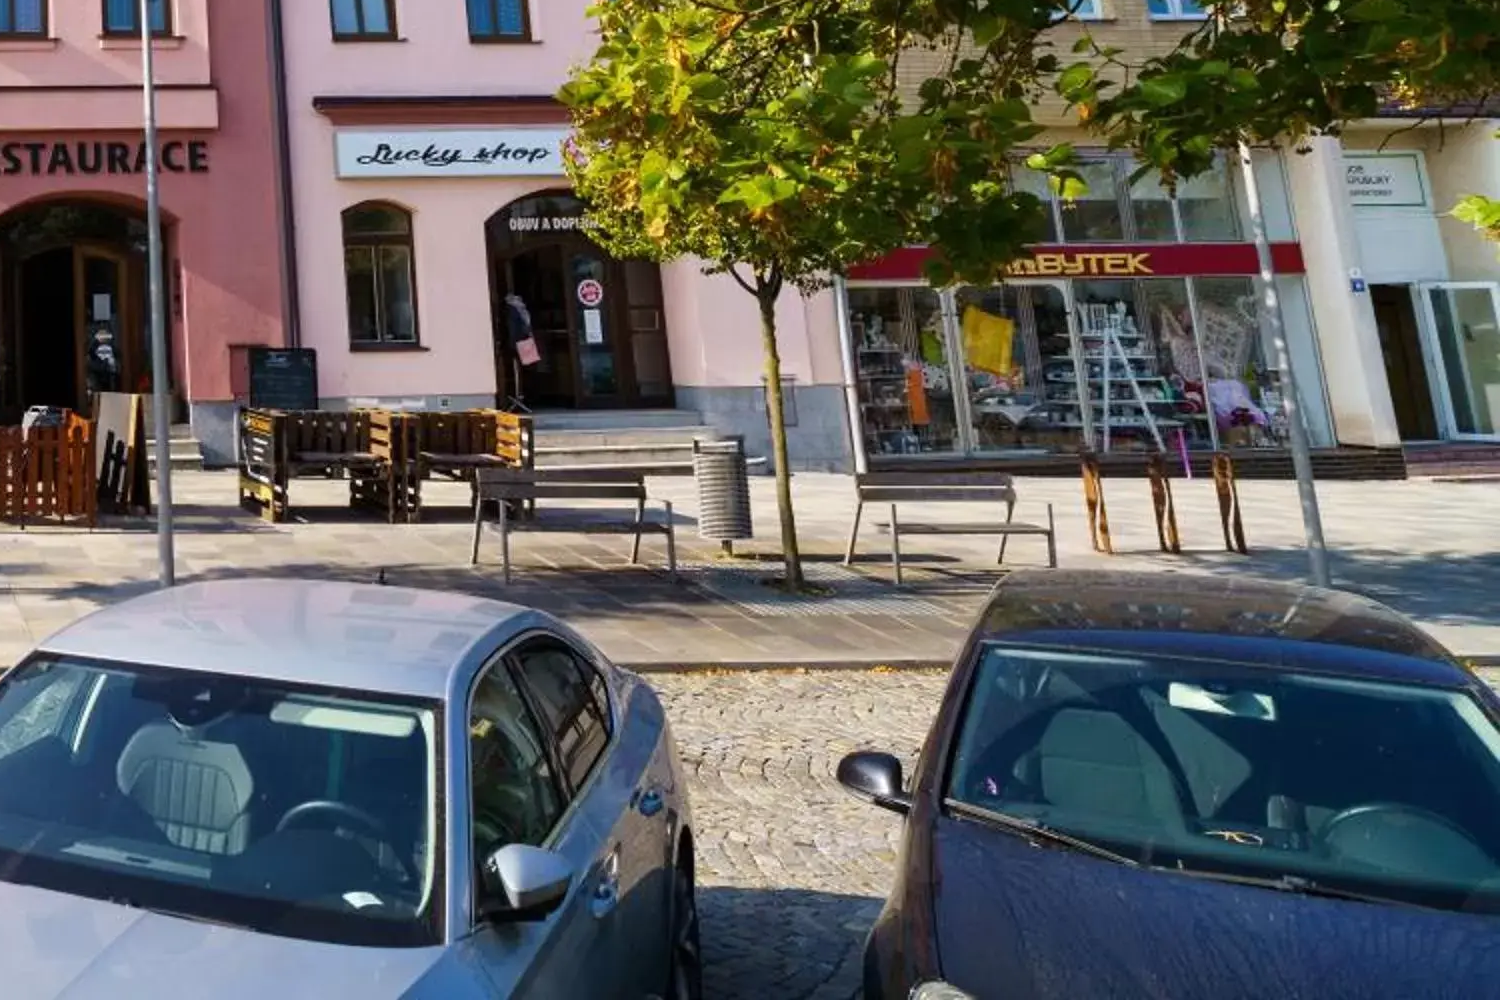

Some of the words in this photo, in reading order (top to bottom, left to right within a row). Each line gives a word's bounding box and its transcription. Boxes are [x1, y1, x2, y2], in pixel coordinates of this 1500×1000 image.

[356, 143, 461, 166] Lucky
[473, 142, 550, 164] shop
[509, 217, 539, 231] OBUV
[541, 217, 551, 230] A
[1007, 253, 1154, 275] BYTEK
